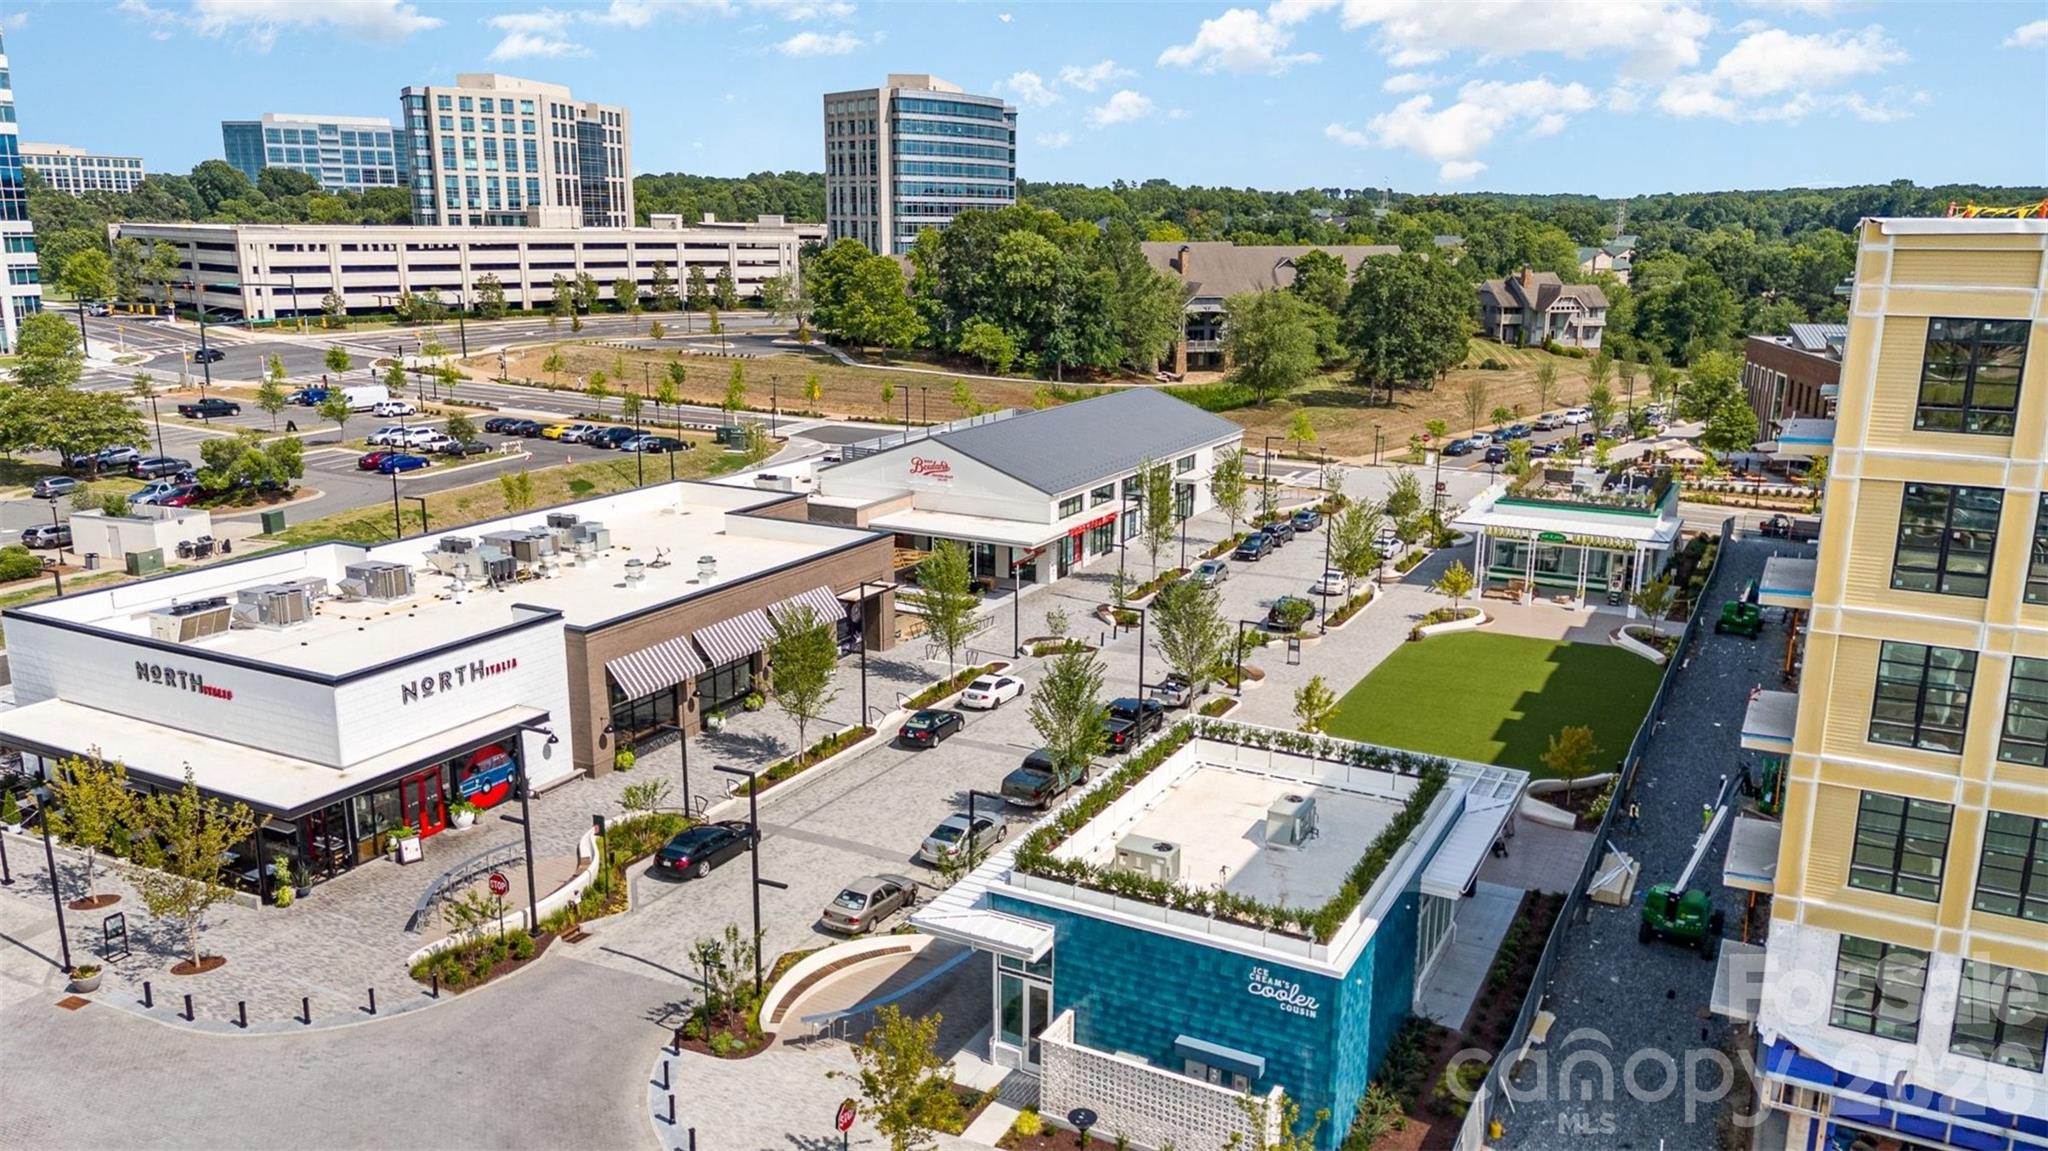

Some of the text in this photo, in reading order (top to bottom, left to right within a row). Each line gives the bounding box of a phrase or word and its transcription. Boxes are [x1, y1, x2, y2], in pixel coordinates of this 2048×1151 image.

[135, 660, 203, 693] NORTH
[401, 658, 518, 705] NORTH ITALIA
[1252, 966, 1269, 977] ICE
[1249, 972, 1290, 989] CREAM'S
[1280, 1002, 1317, 1018] COUSIN
